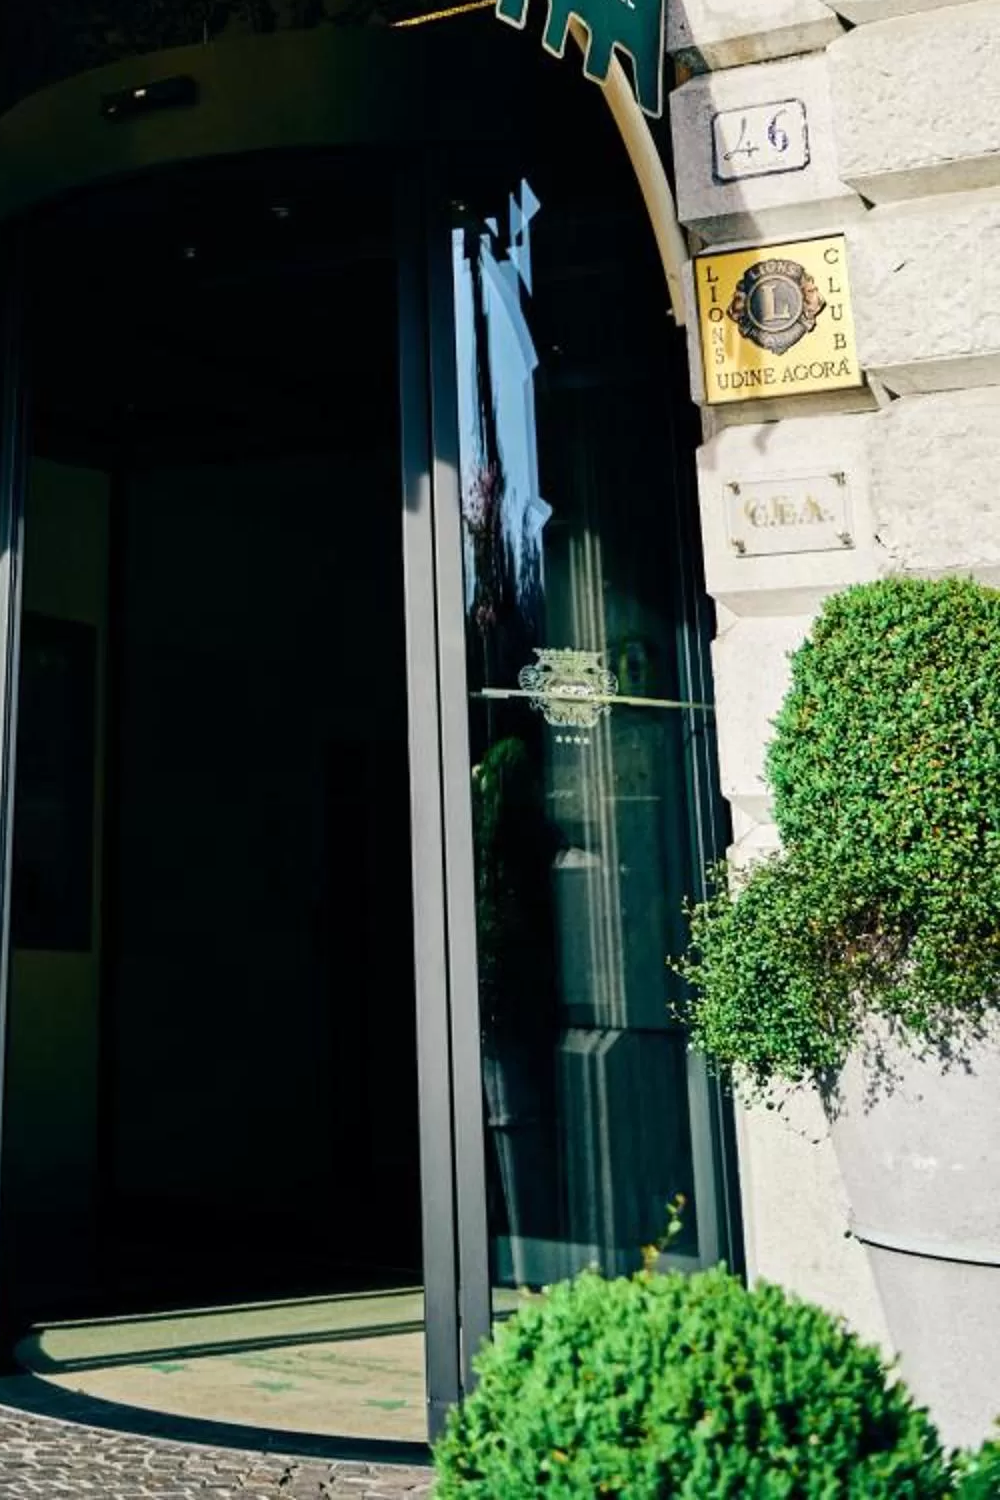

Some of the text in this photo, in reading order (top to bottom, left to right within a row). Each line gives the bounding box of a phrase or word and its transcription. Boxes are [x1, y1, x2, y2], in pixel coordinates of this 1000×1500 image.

[723, 108, 789, 161] 46
[706, 265, 725, 365] LIONS
[761, 284, 791, 321] L
[823, 247, 847, 350] CLUB
[716, 367, 776, 390] UDINE
